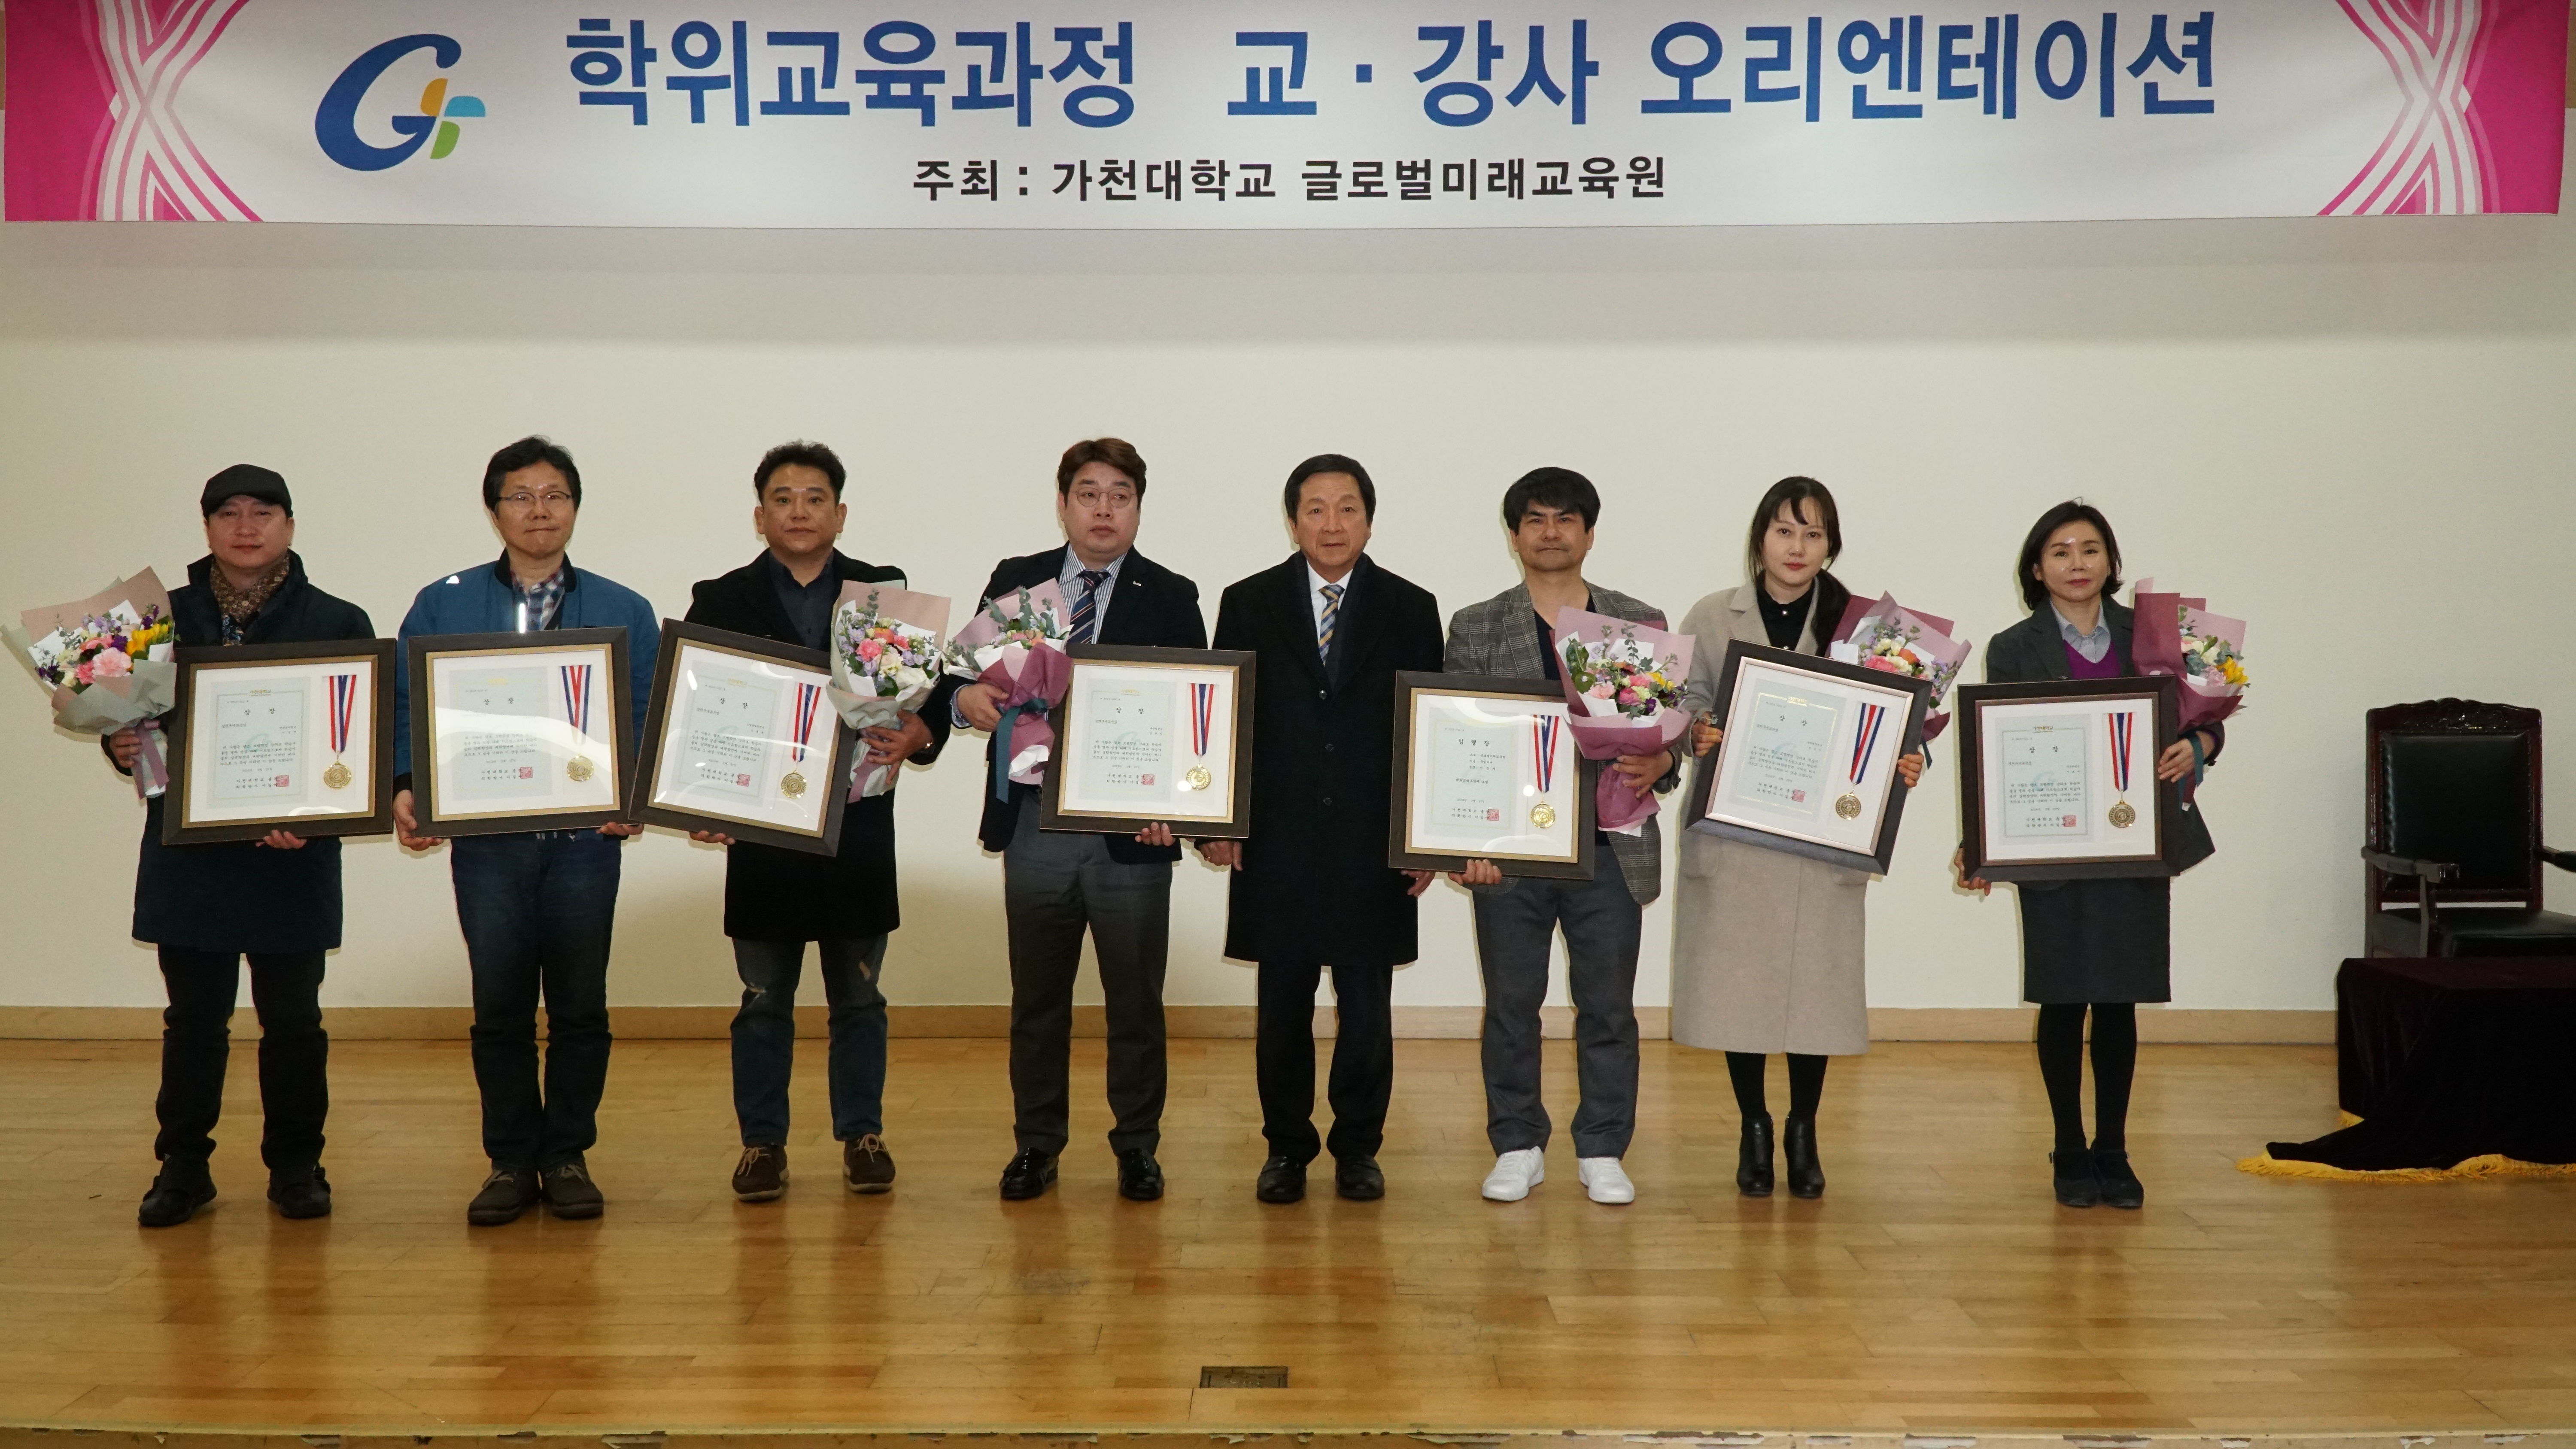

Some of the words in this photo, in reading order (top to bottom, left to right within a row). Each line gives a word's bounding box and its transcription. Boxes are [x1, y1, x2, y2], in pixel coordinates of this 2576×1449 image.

[566, 18, 1135, 128] 학위교육과정
[1413, 19, 1599, 127] 강사
[1640, 11, 2215, 123] 오리엔테이션
[1052, 159, 1276, 202] 가천대학교
[1301, 156, 1664, 201] 글로벌미래교육원
